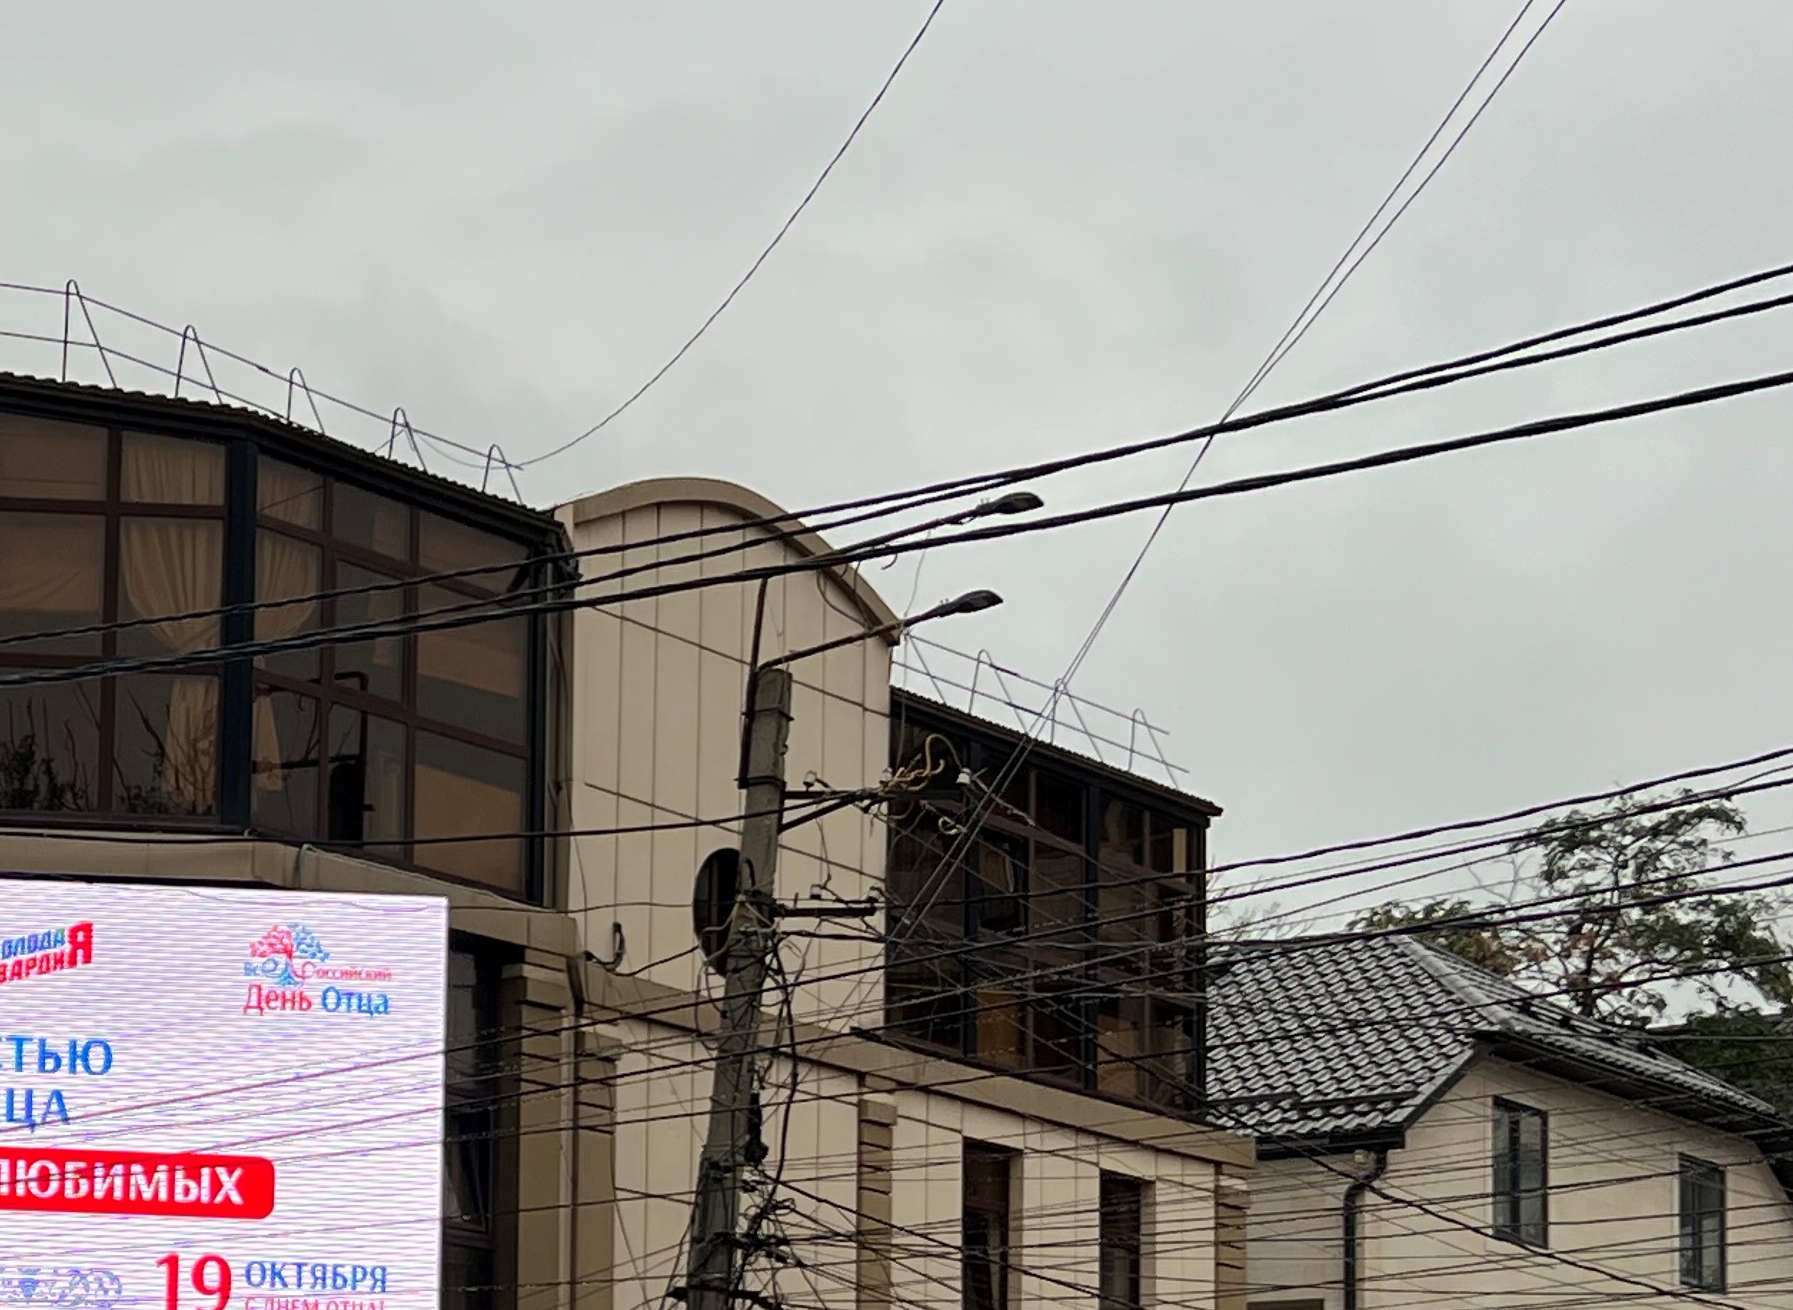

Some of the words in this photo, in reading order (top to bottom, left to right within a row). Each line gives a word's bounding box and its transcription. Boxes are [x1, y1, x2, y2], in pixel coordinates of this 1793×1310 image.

[243, 982, 313, 1016] День
[321, 985, 390, 1018] Отца
[245, 1260, 388, 1293] ОКТЯБРЯ
